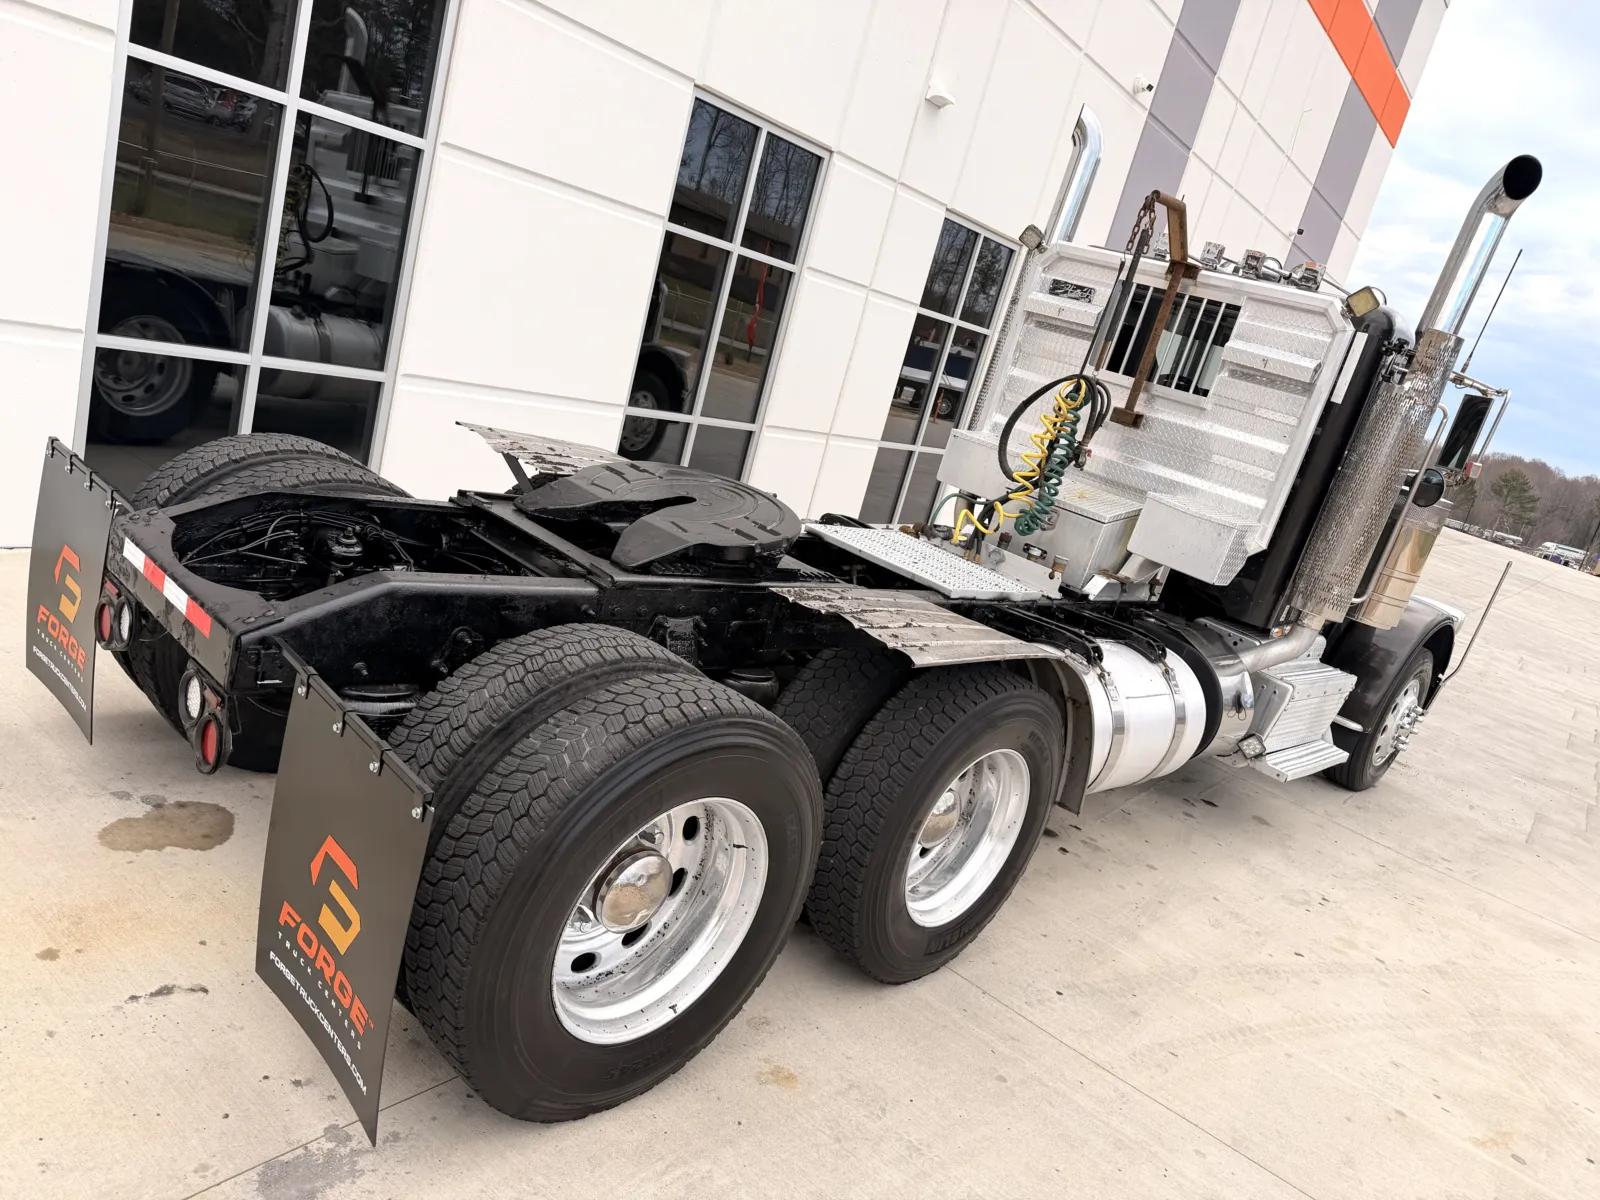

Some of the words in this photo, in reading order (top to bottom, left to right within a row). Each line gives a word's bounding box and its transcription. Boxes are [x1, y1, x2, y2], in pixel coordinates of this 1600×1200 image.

[36, 604, 87, 672] FORGE
[269, 950, 367, 1096] FORGETRUCKCENTERS.COM
[278, 900, 368, 1037] FORGE
[278, 931, 312, 976] TRUCK
[317, 980, 361, 1051] CENTERS
